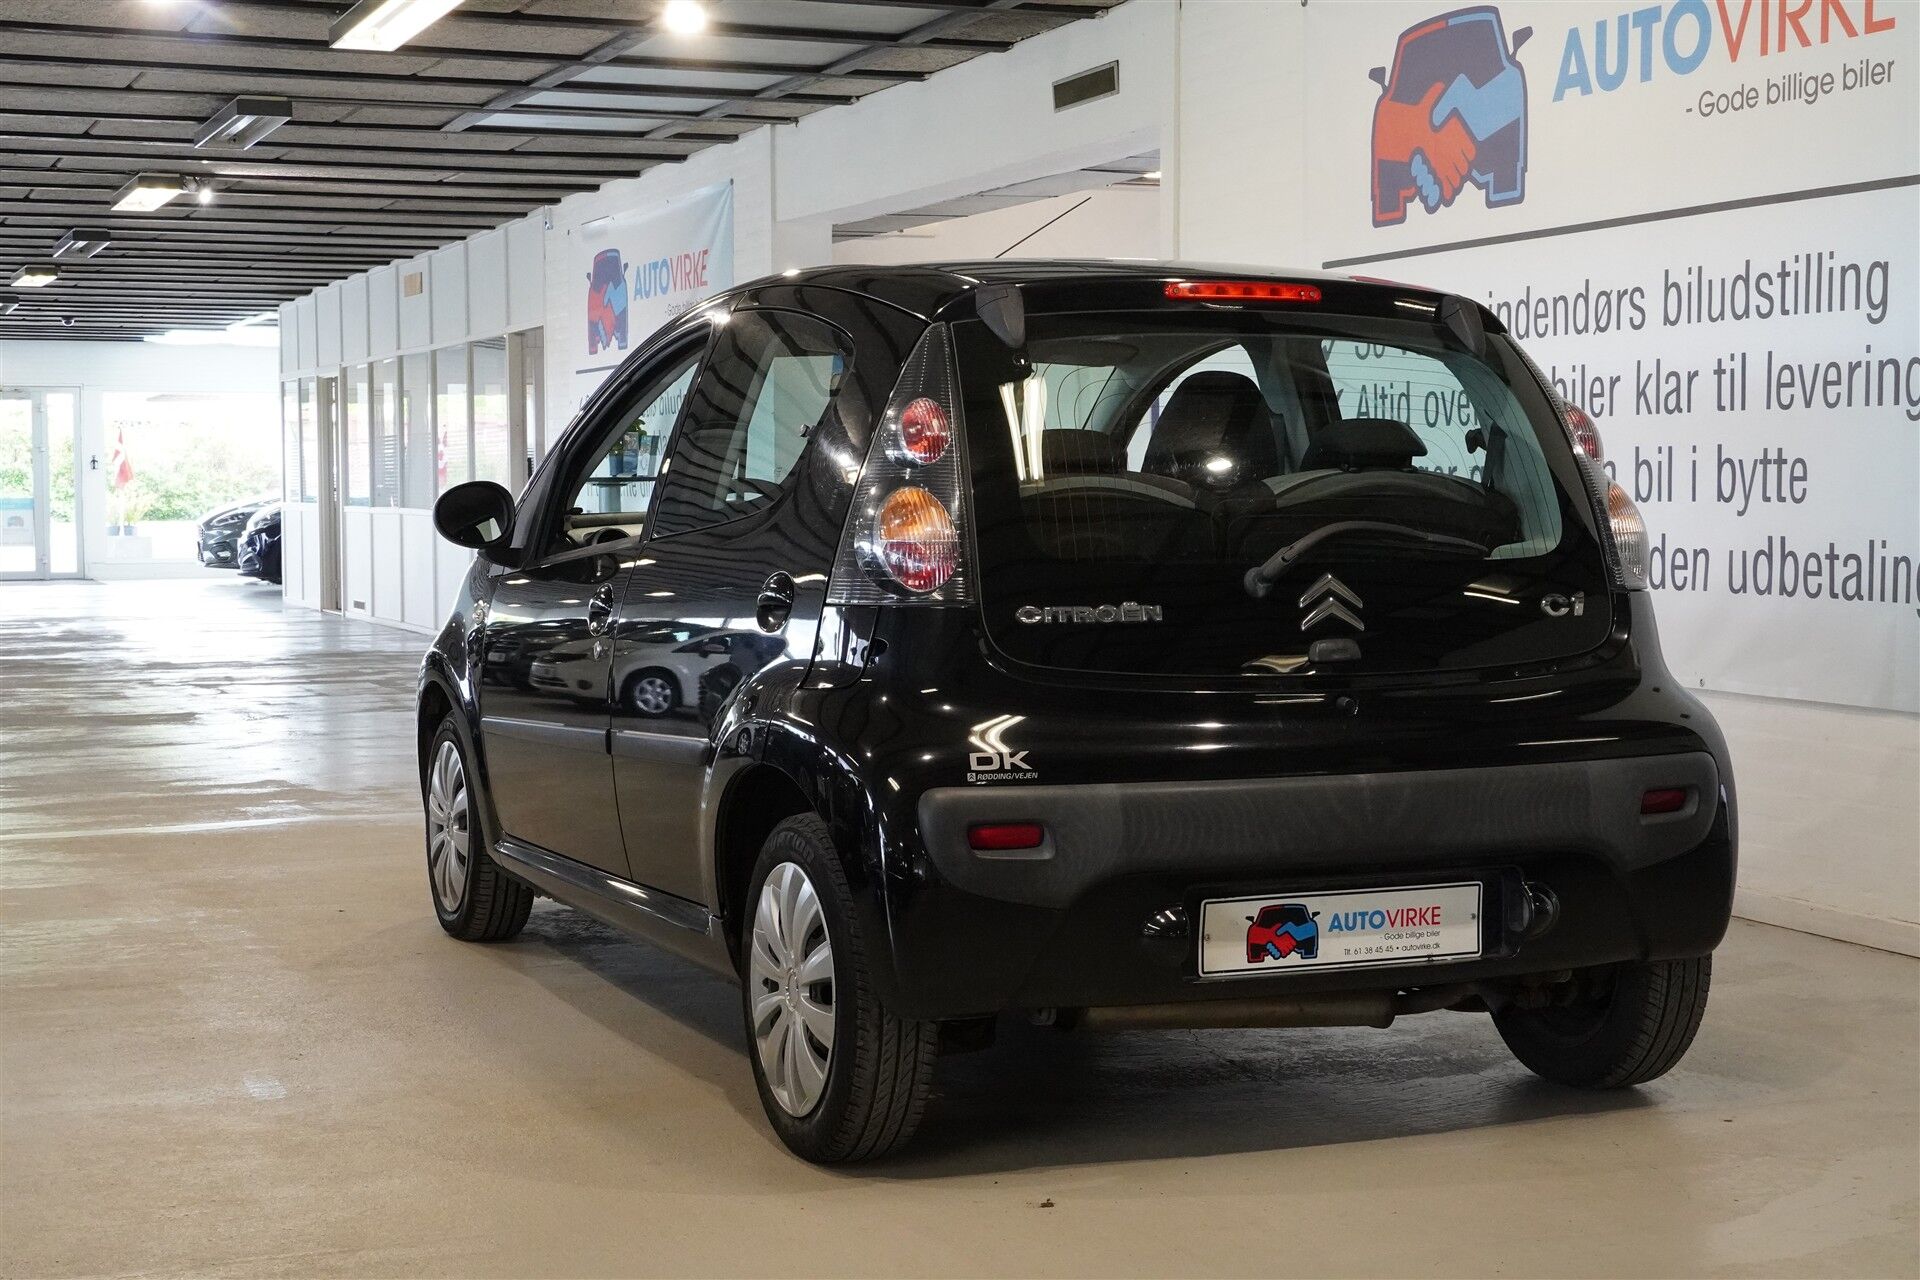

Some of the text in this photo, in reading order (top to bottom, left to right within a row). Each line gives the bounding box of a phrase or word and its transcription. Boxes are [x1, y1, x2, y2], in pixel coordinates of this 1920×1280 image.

[1698, 84, 1759, 118] Gode
[1766, 71, 1834, 105] billige
[1842, 59, 1895, 91] biler
[633, 248, 709, 301] AUTOVIRKE
[1488, 251, 1890, 340] ndendørs biludstilling
[1356, 380, 1411, 425] Altid
[1635, 358, 1699, 416] klar
[1713, 352, 1747, 411] til
[1766, 344, 1920, 421] levering
[1634, 444, 1808, 517] bil i bytte
[1728, 535, 1920, 619] udbetalin
[1015, 601, 1163, 624] CITROËN
[969, 751, 1033, 771] DK
[1328, 906, 1441, 932] AUTOVIRKE
[1384, 932, 1404, 941] Gode
[1354, 947, 1362, 955] 61
[1364, 946, 1373, 955] 38
[1375, 945, 1384, 954] 45
[1385, 944, 1394, 953] 45
[1401, 942, 1441, 952] autovirke.dk
